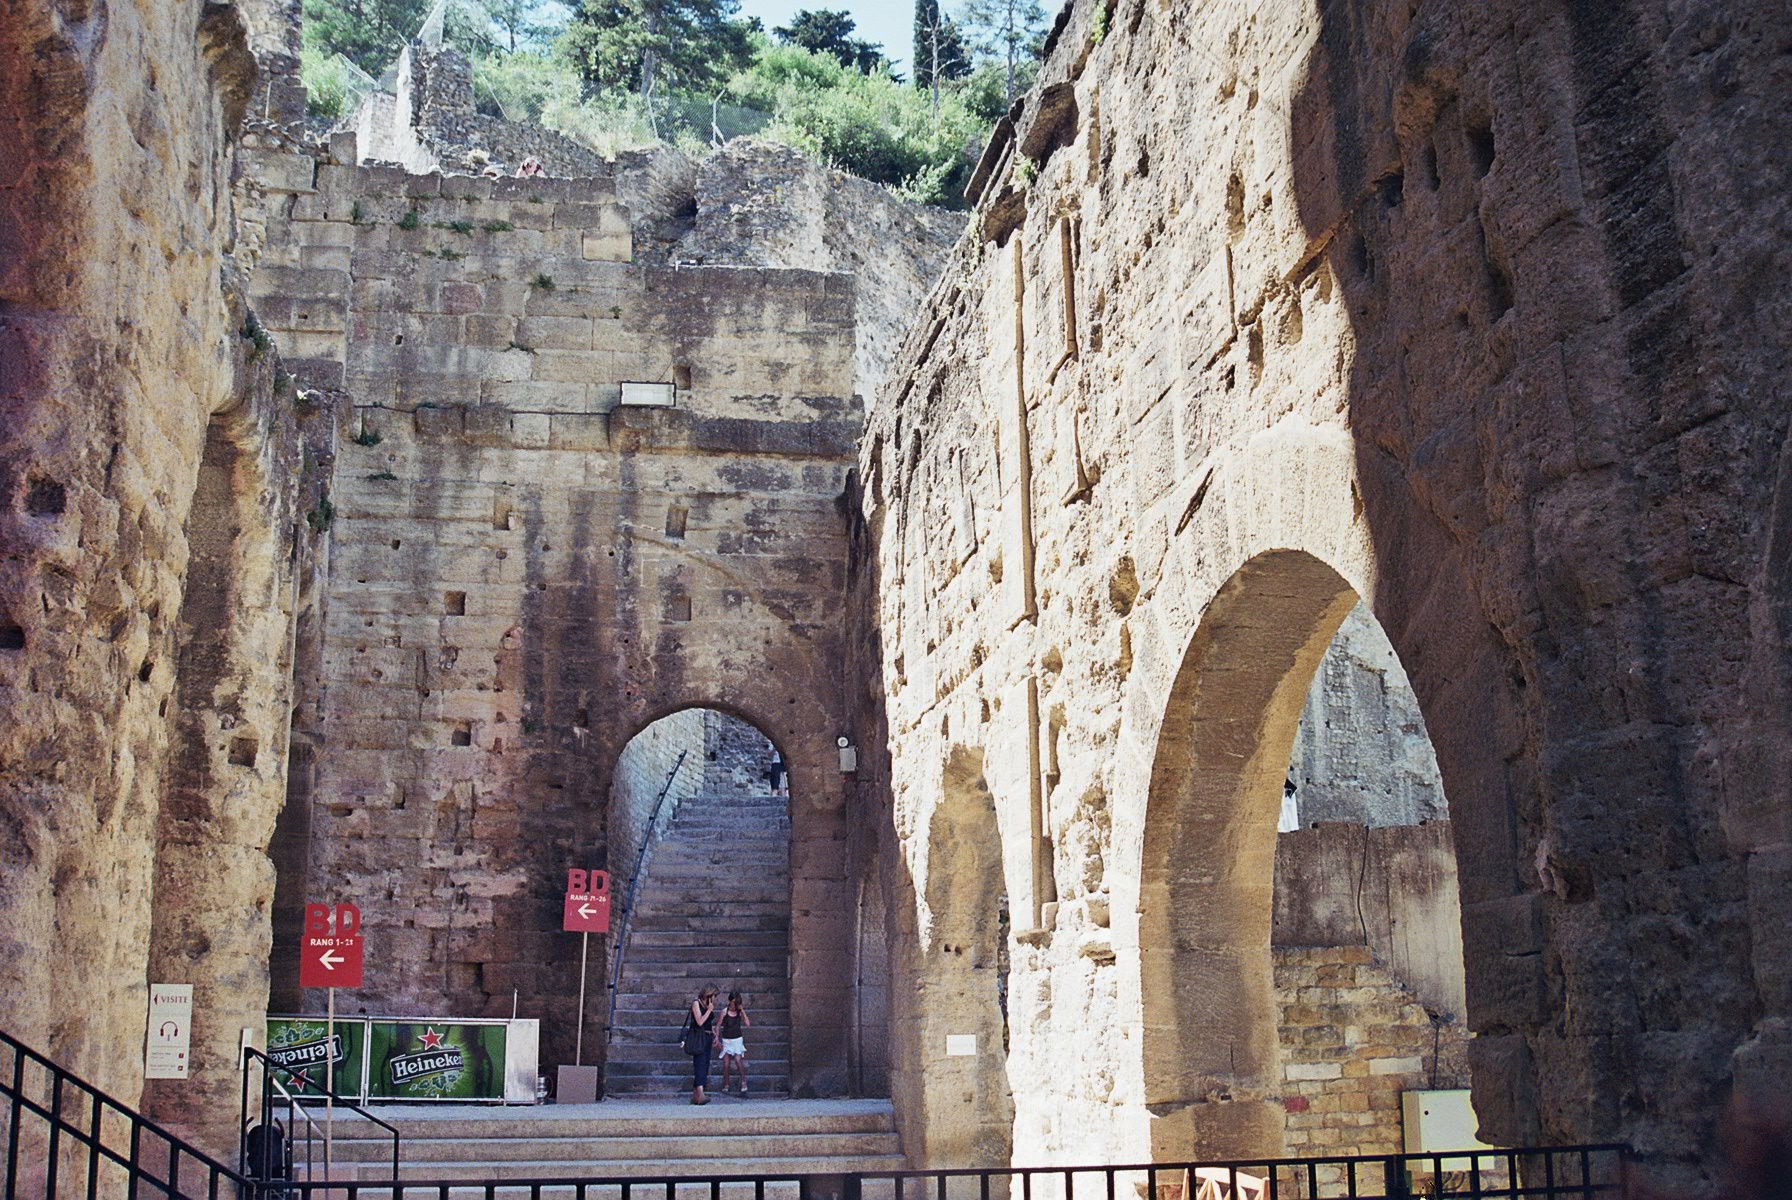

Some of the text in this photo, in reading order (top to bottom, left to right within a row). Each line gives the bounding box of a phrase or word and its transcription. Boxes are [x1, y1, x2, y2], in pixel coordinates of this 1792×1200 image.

[568, 868, 609, 894] BD
[570, 894, 588, 903] RANG
[305, 904, 361, 936] BD
[310, 938, 334, 946] RANG
